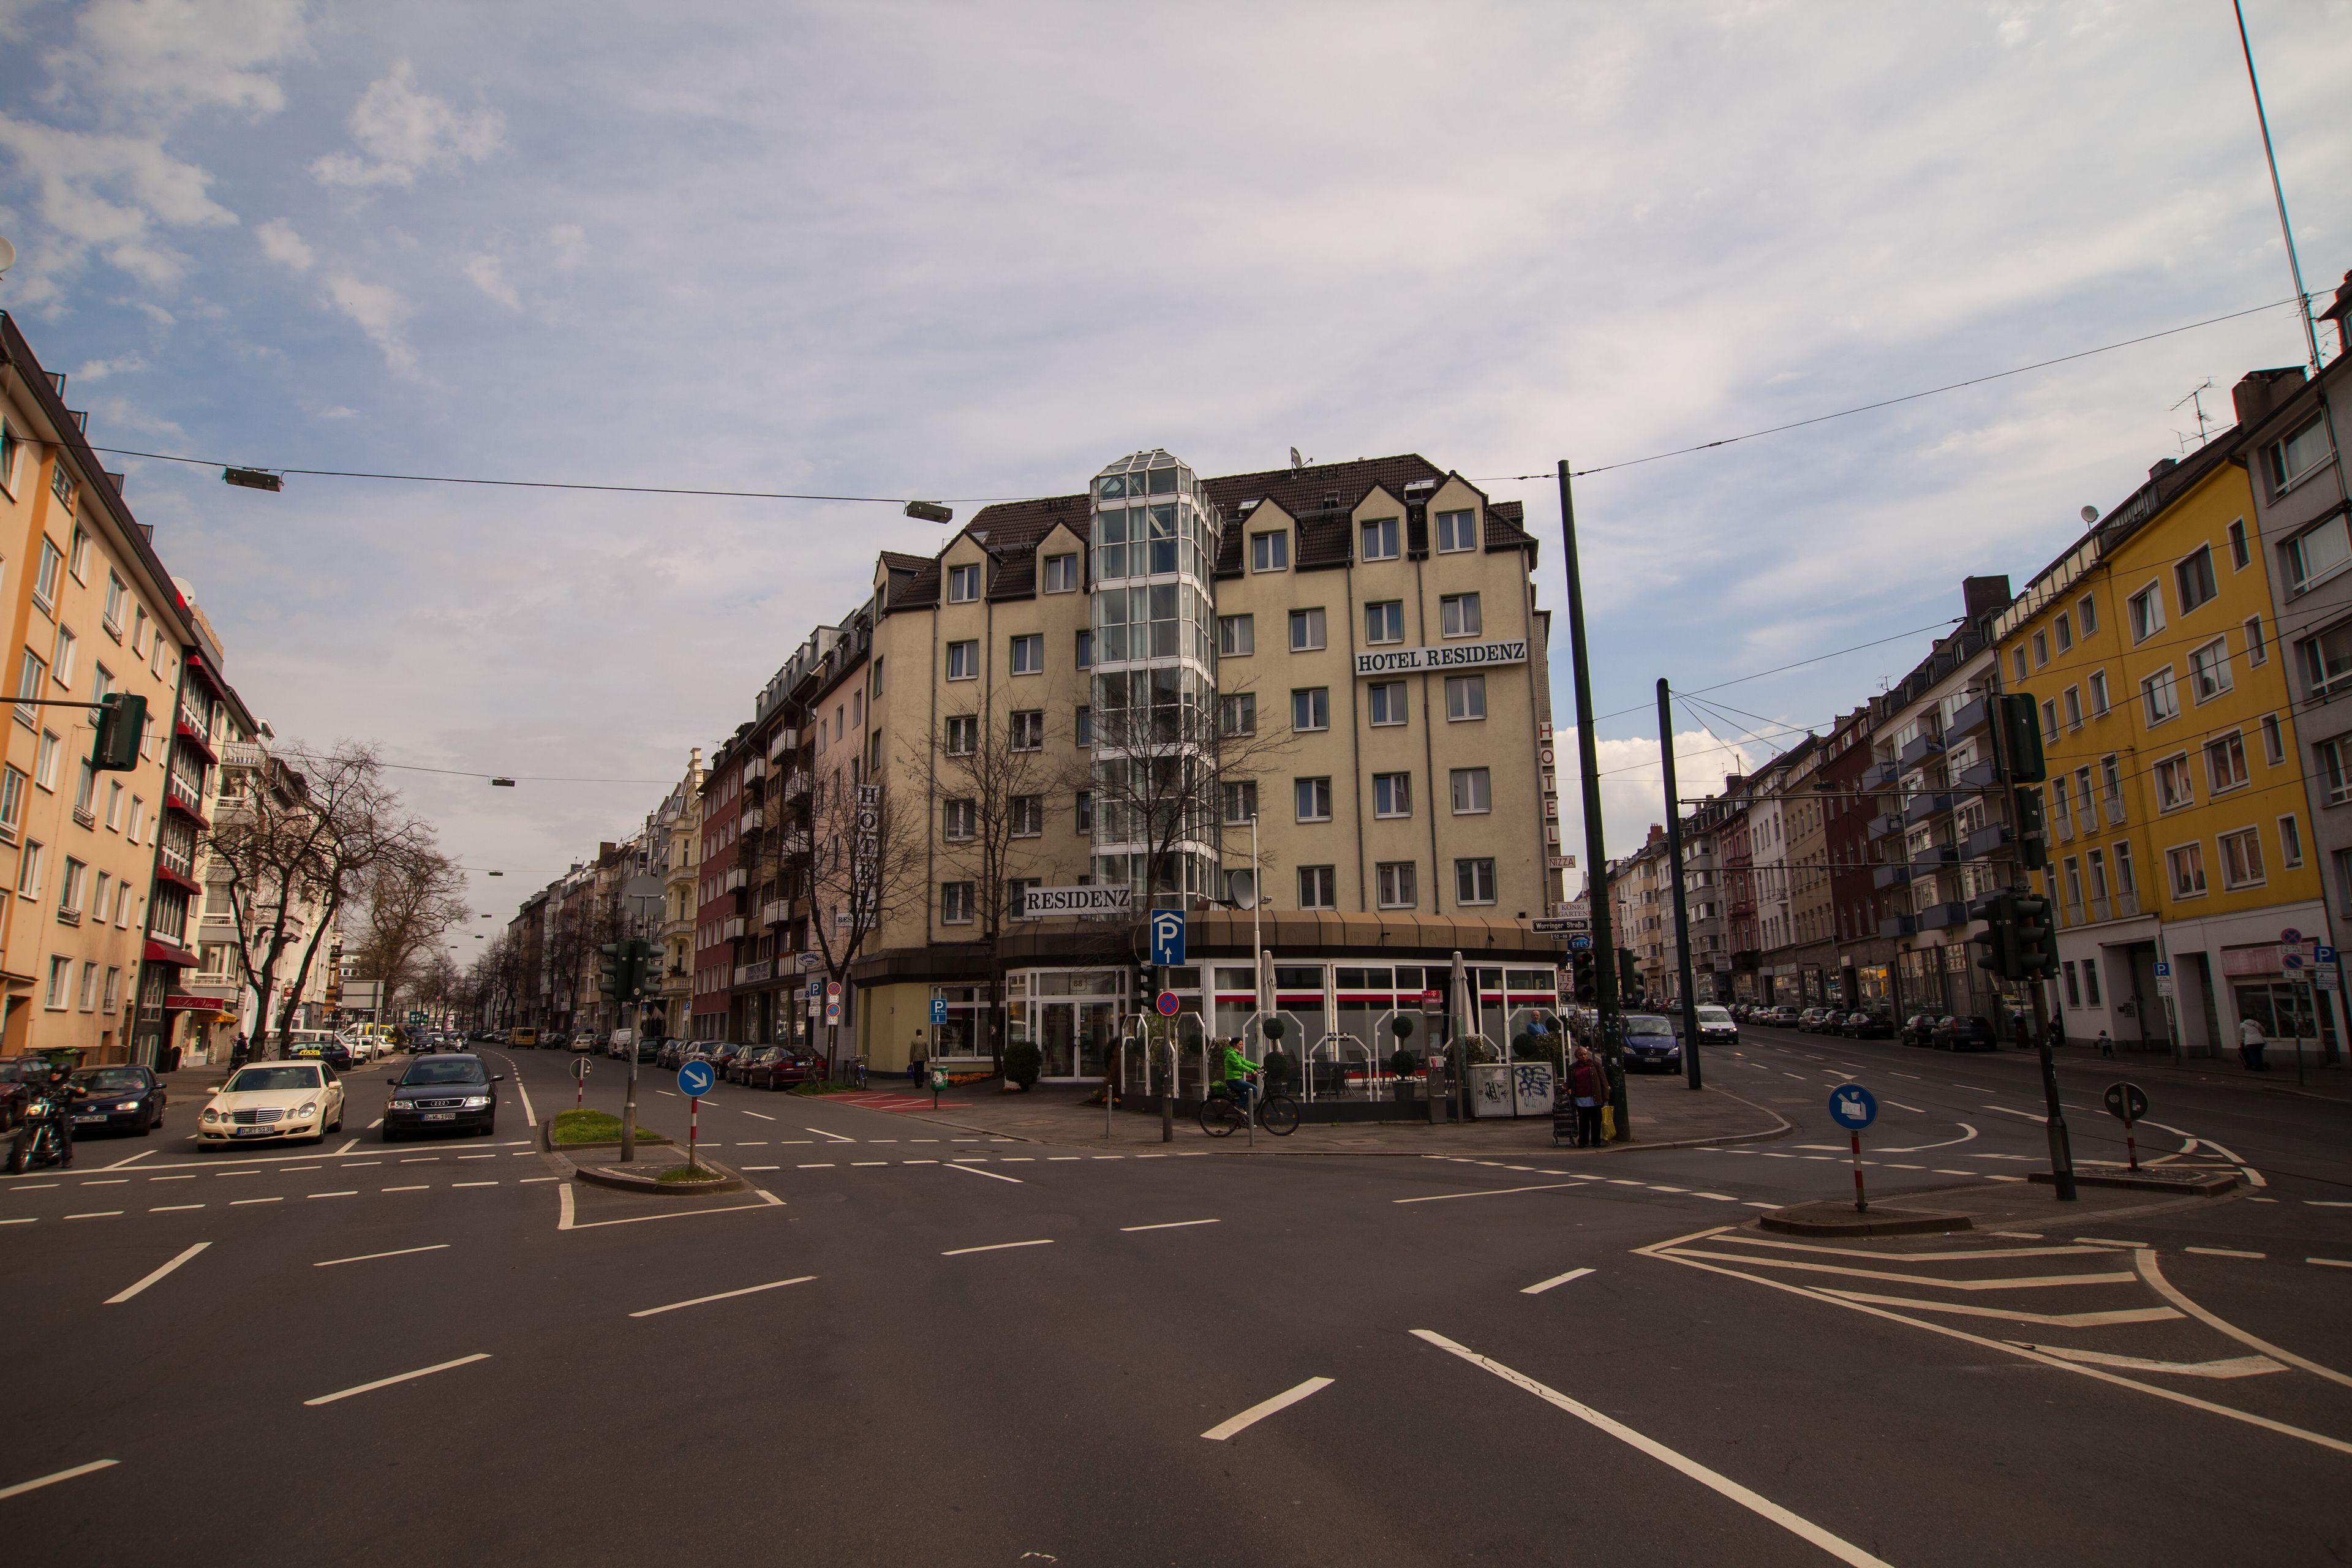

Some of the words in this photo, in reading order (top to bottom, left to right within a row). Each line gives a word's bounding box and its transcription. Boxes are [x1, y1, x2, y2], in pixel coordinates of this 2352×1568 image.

[1358, 651, 1421, 671] HOTEL
[1426, 642, 1525, 666] RESIDENZ
[1539, 723, 1557, 842] HOTEL
[1549, 858, 1575, 866] NIZZA
[1027, 889, 1130, 910] RESIDENZ
[1158, 922, 1178, 951] P
[2320, 949, 2330, 962] P
[2157, 965, 2166, 974] P
[812, 984, 819, 995] P
[935, 1001, 944, 1014] P
